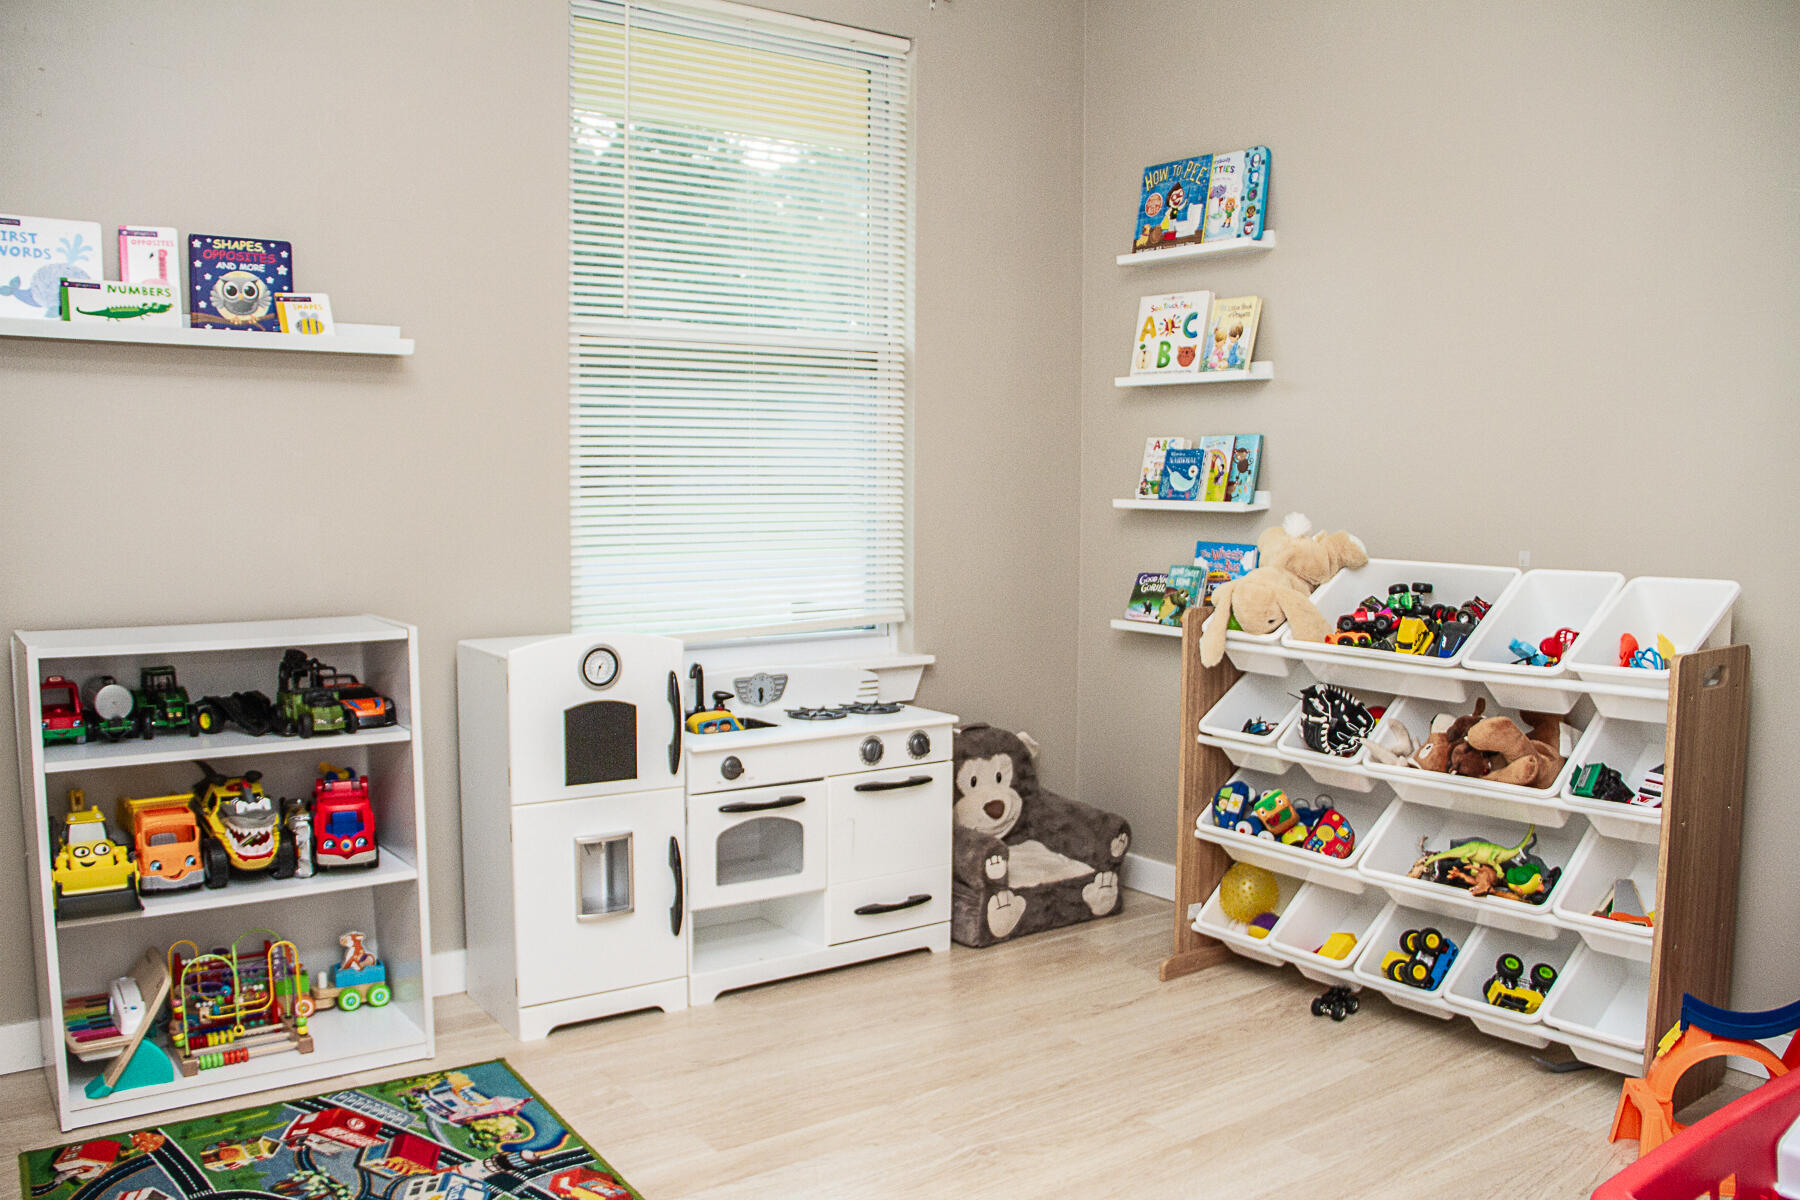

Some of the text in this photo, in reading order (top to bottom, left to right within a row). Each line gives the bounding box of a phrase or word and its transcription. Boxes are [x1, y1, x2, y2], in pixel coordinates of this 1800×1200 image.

[1213, 165, 1235, 174] TTIES
[1144, 166, 1168, 191] HOW
[1172, 164, 1182, 177] TO
[0, 230, 38, 244] IRST
[131, 239, 174, 247] OPPOSITES
[202, 249, 276, 264] OPPOSITES
[216, 261, 265, 272] AND MORE
[107, 285, 172, 297] NUMBERS
[1140, 583, 1166, 593] GORILL
